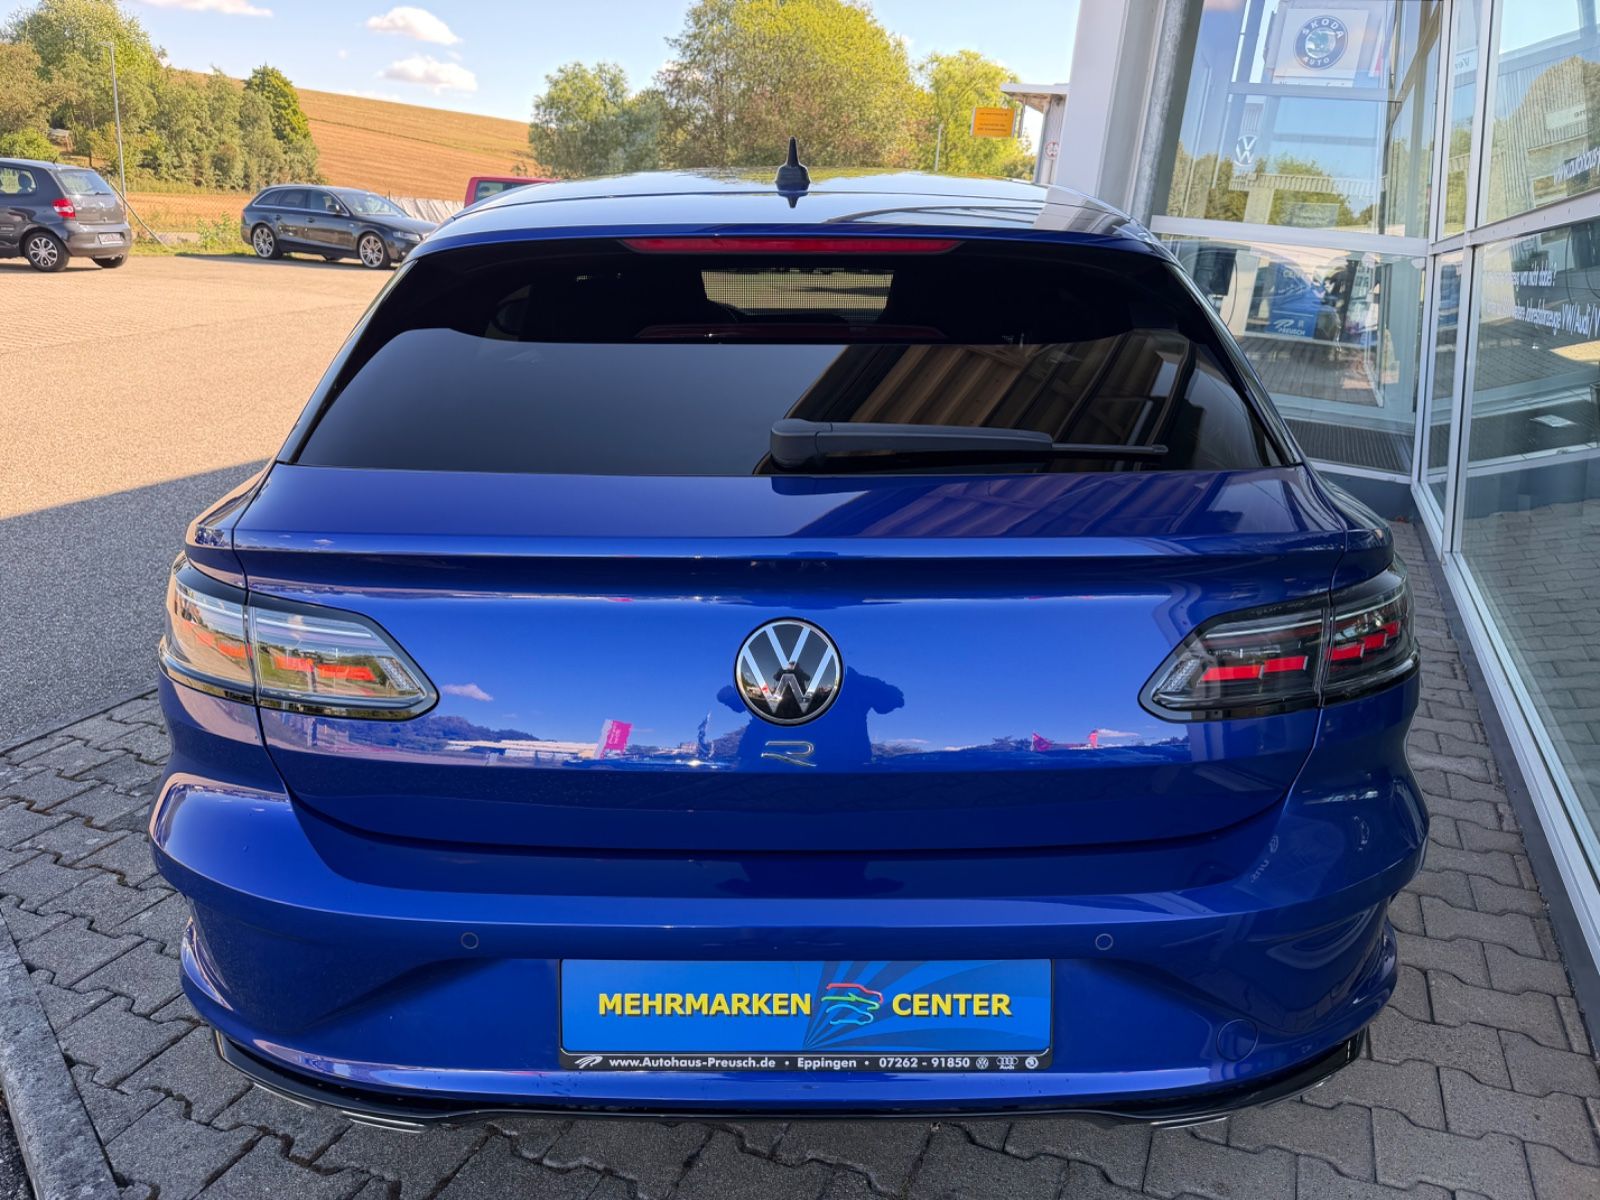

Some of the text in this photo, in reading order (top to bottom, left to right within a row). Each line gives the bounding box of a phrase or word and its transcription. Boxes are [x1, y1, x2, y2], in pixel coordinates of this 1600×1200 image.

[760, 740, 817, 767] R
[598, 993, 1013, 1016] MEHRMARKEN CENTER
[608, 1056, 776, 1068] www.Autohaus-Preusch.de
[797, 1057, 857, 1070] Eppingen
[878, 1057, 918, 1068] 07262
[931, 1057, 970, 1068] 91850
